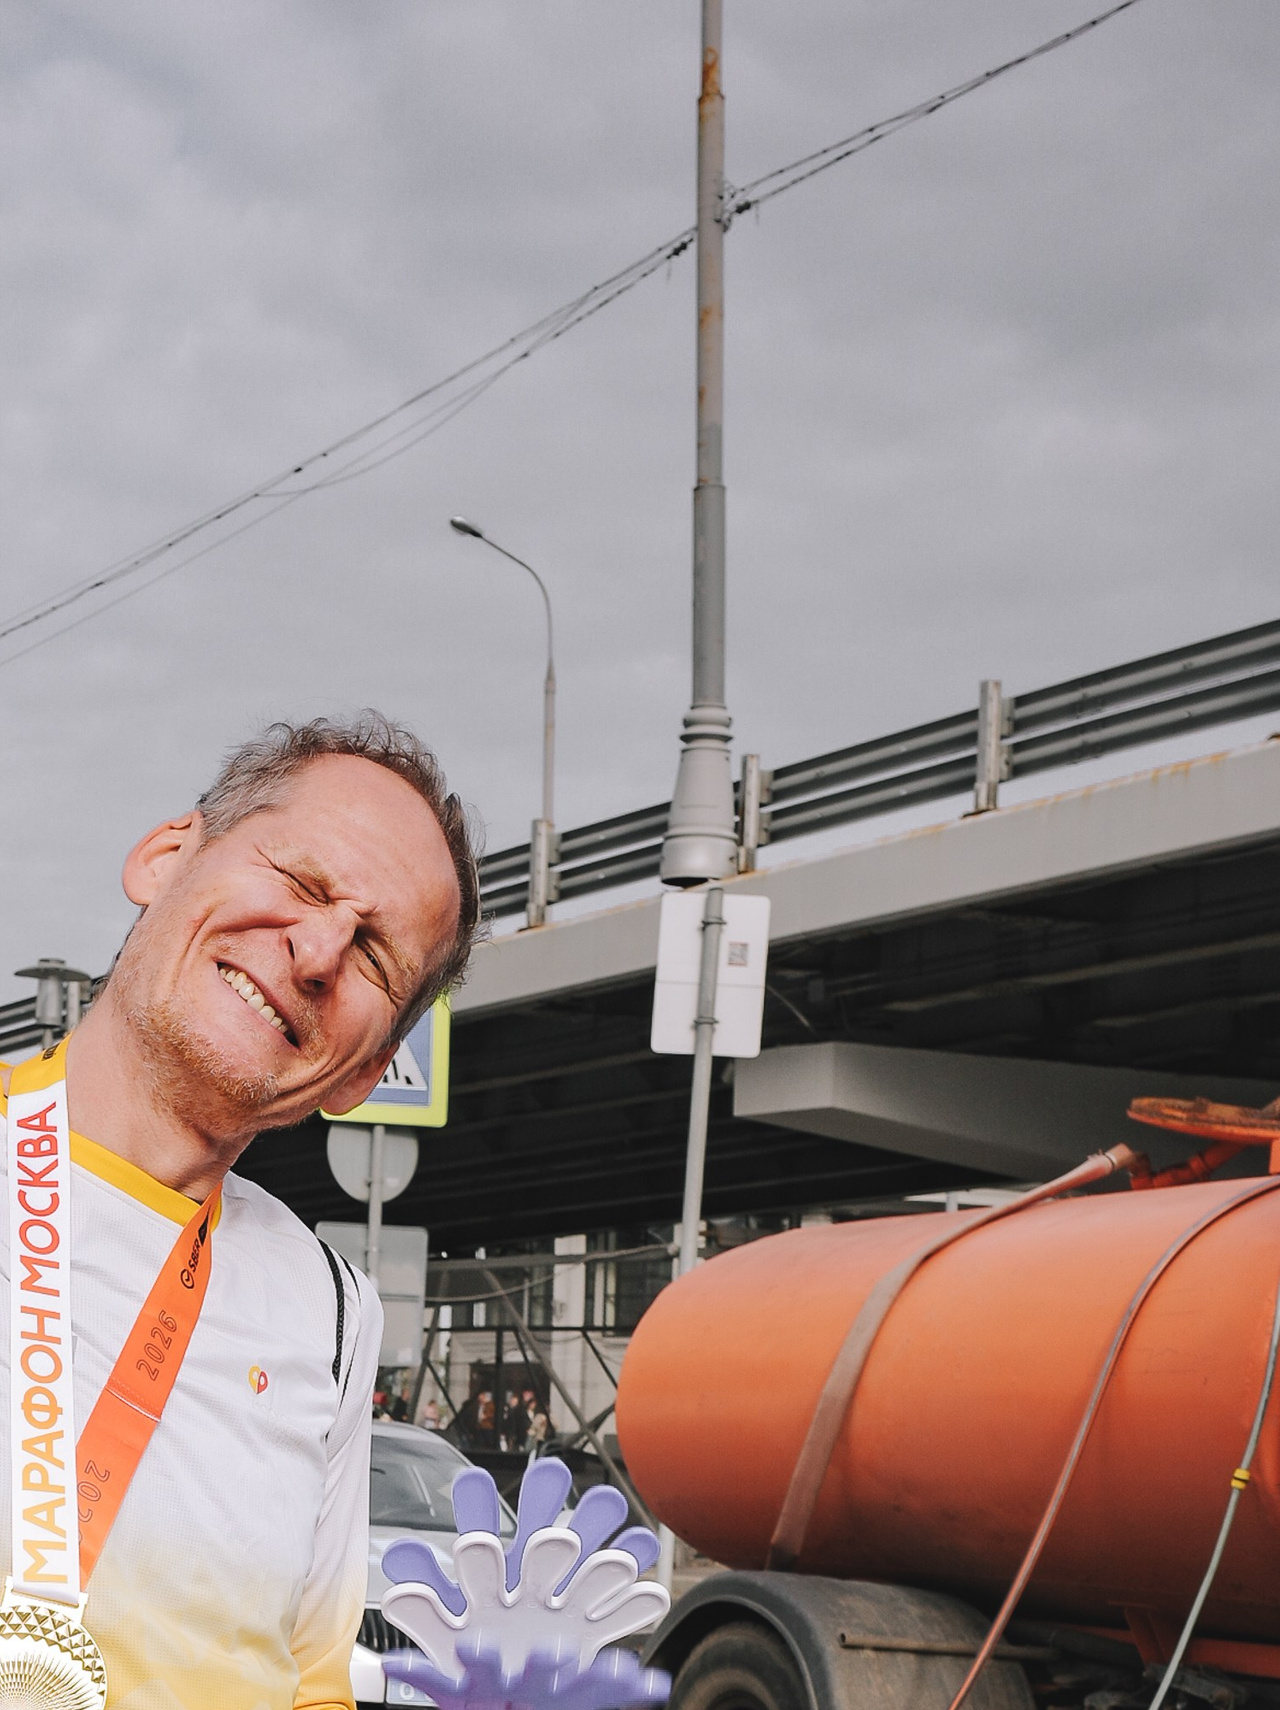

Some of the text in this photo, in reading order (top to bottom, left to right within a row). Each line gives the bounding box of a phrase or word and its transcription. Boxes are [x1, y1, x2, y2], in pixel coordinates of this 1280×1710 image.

[188, 1238, 201, 1273] SBER
[17, 1101, 68, 1584] МАРАФОН МОСКВА
[136, 1310, 178, 1381] 2026
[77, 1460, 111, 1544] 202
